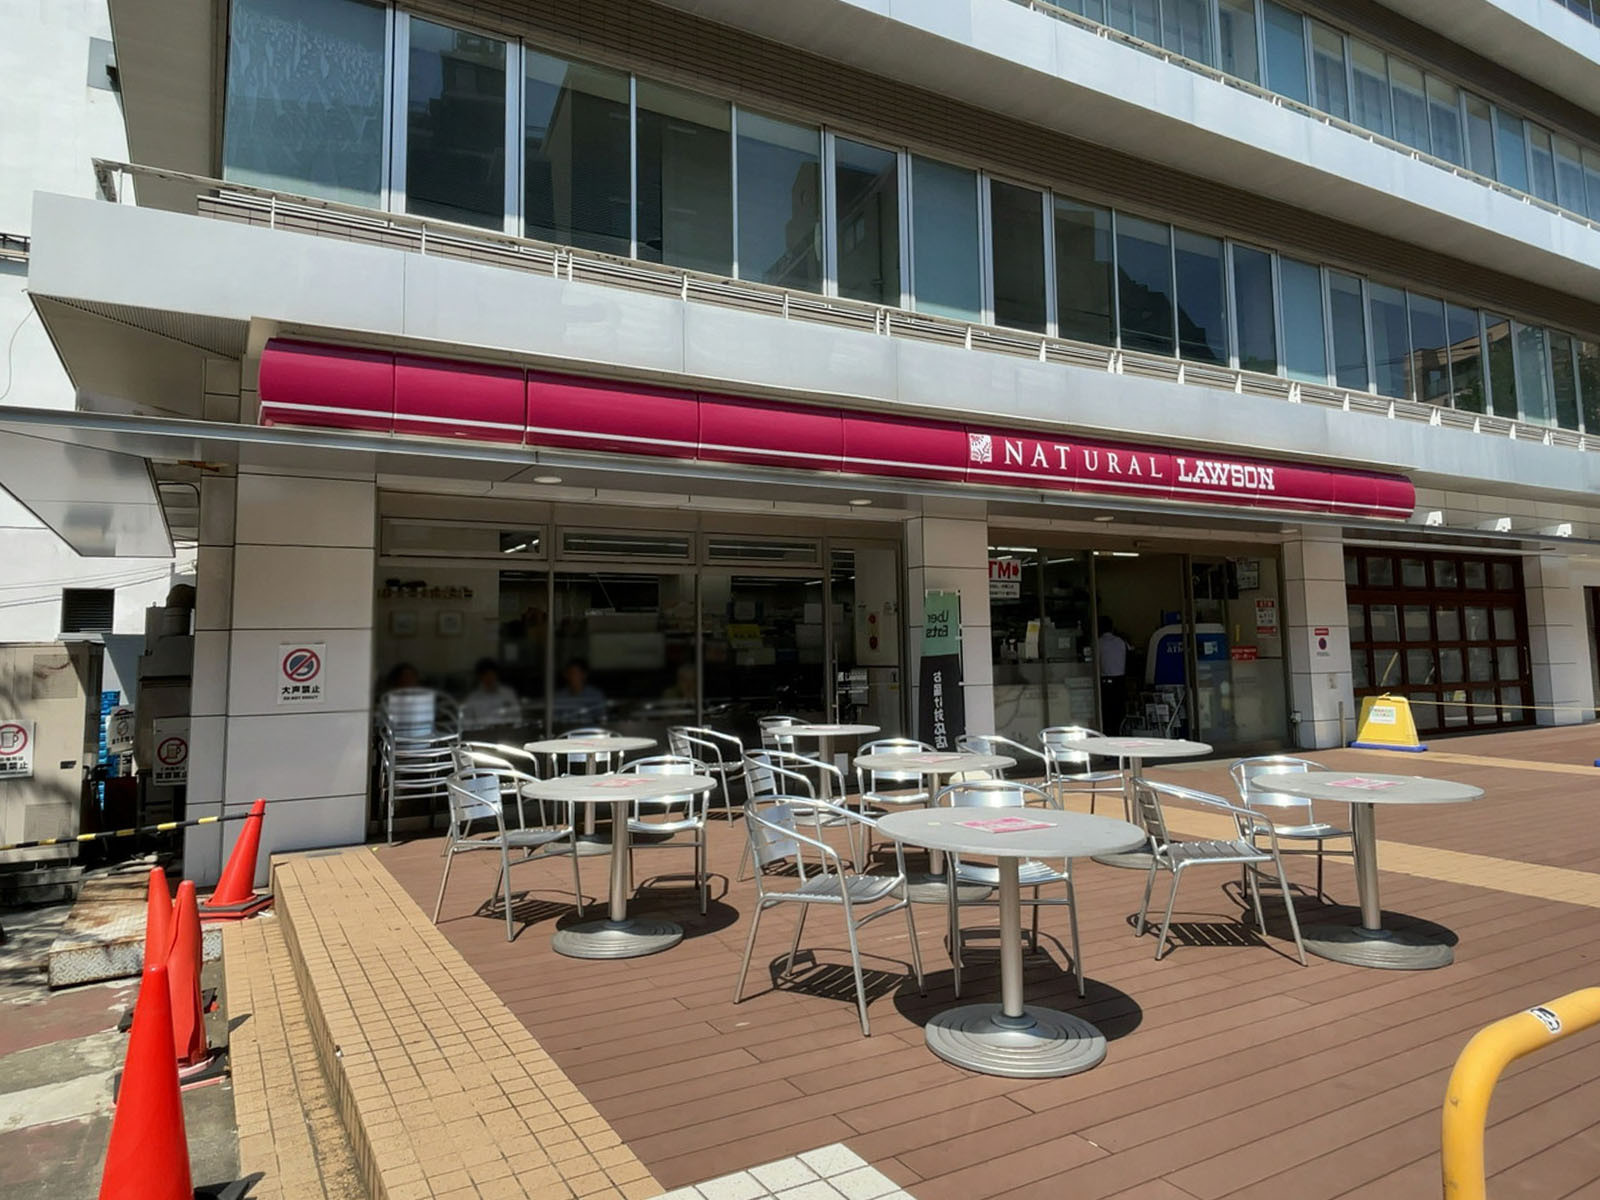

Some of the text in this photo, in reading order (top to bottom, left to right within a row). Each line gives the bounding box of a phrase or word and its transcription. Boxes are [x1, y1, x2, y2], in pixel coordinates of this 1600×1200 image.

[1003, 439, 1275, 490] NATURAL LAWSON
[989, 560, 1011, 579] TM
[282, 685, 320, 694] 大声禁止
